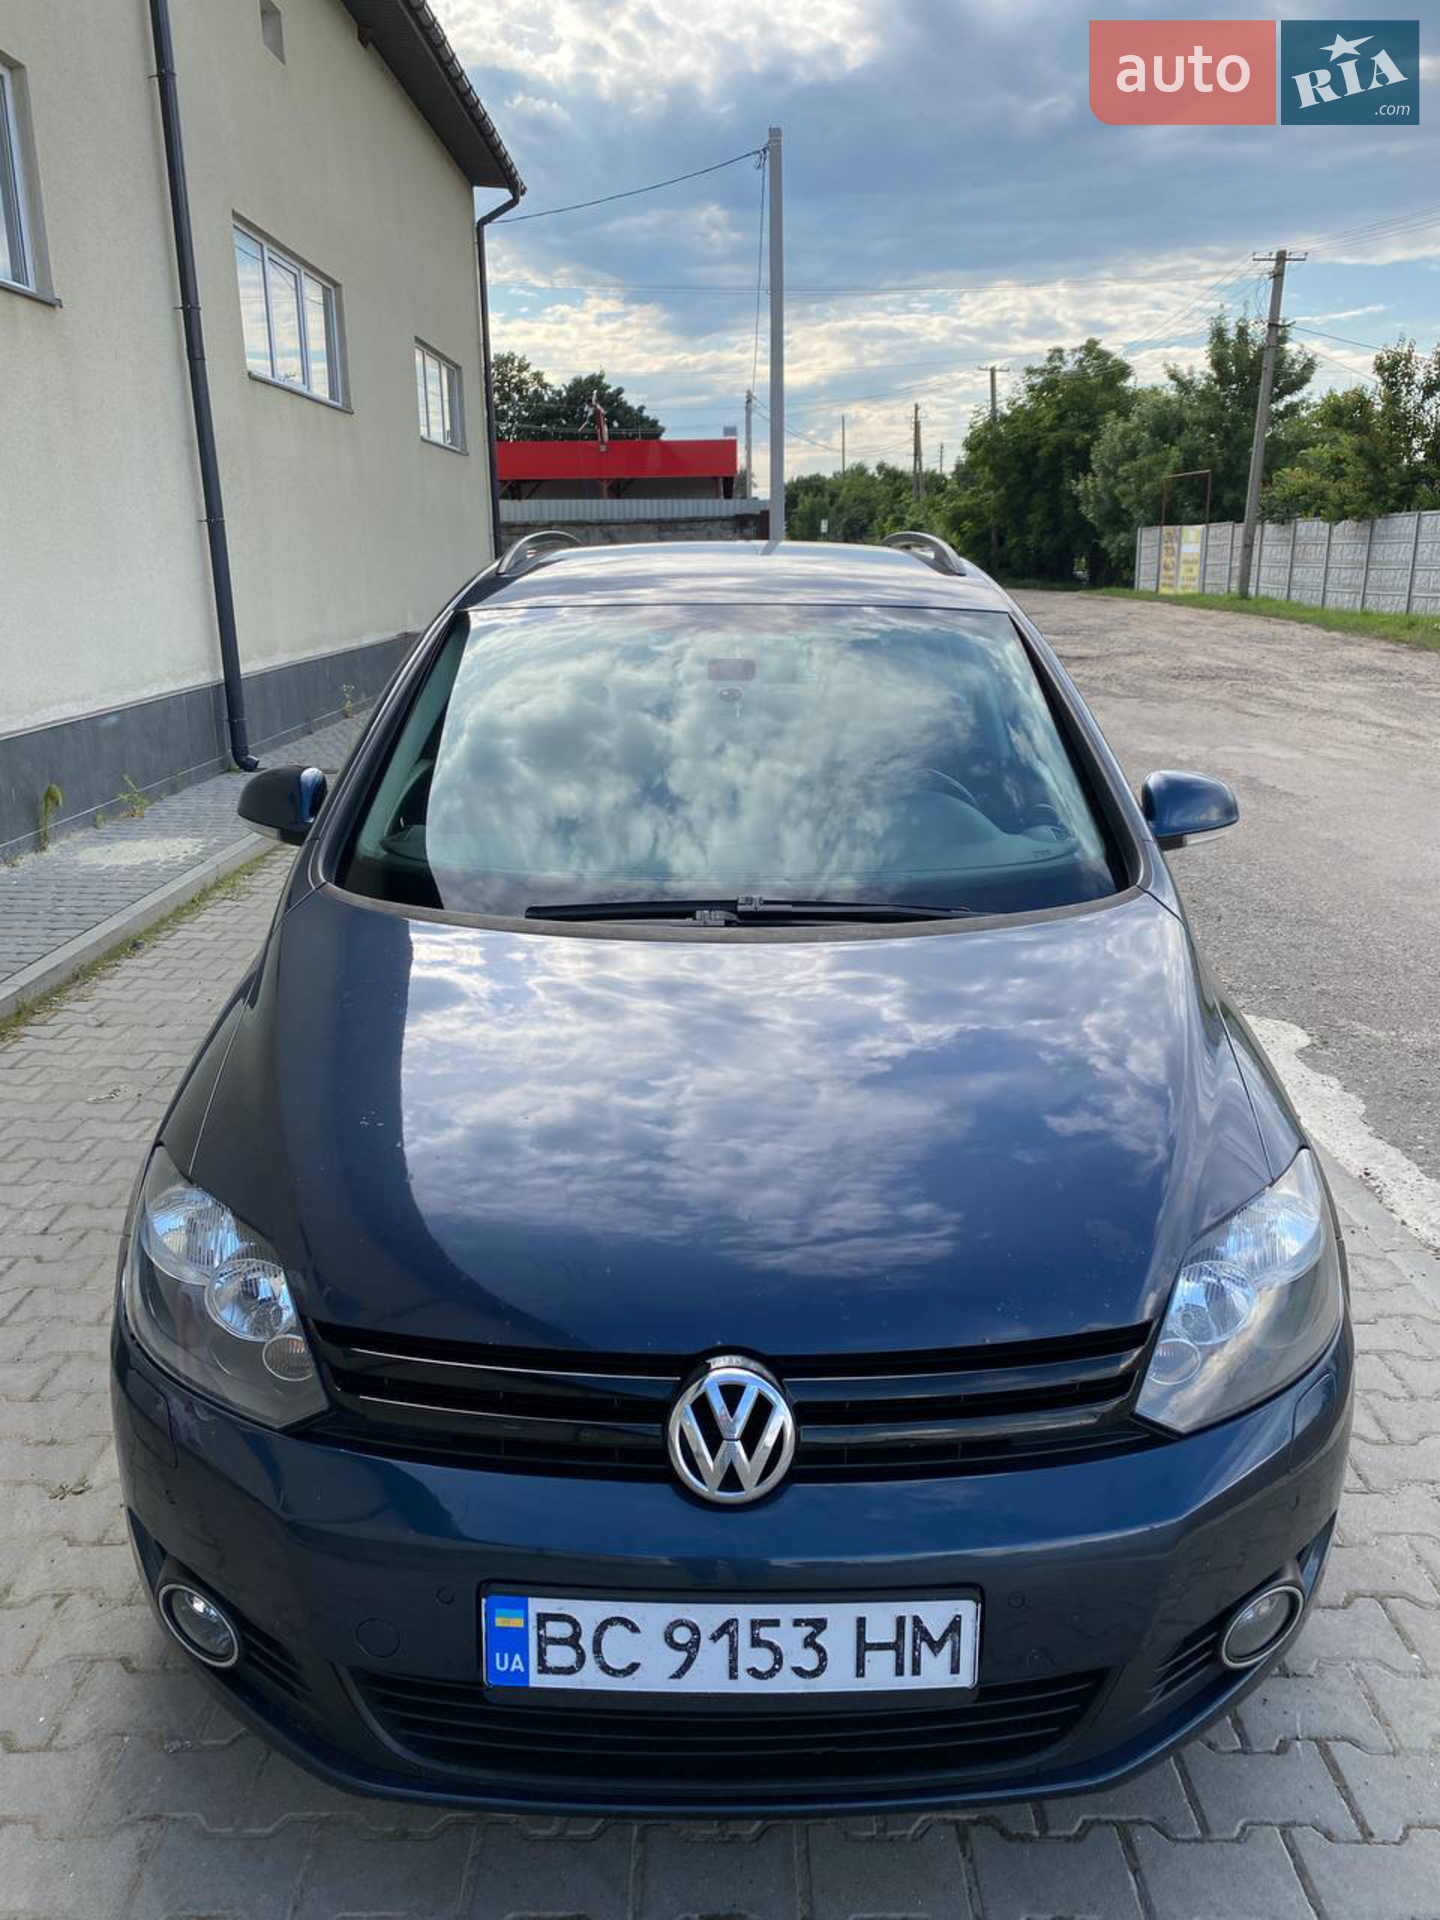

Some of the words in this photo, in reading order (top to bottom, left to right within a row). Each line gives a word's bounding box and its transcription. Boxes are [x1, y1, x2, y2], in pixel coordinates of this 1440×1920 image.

[495, 1652, 525, 1673] UA
[536, 1612, 642, 1678] BC
[664, 1617, 829, 1681] 9153
[855, 1614, 963, 1678] HM
